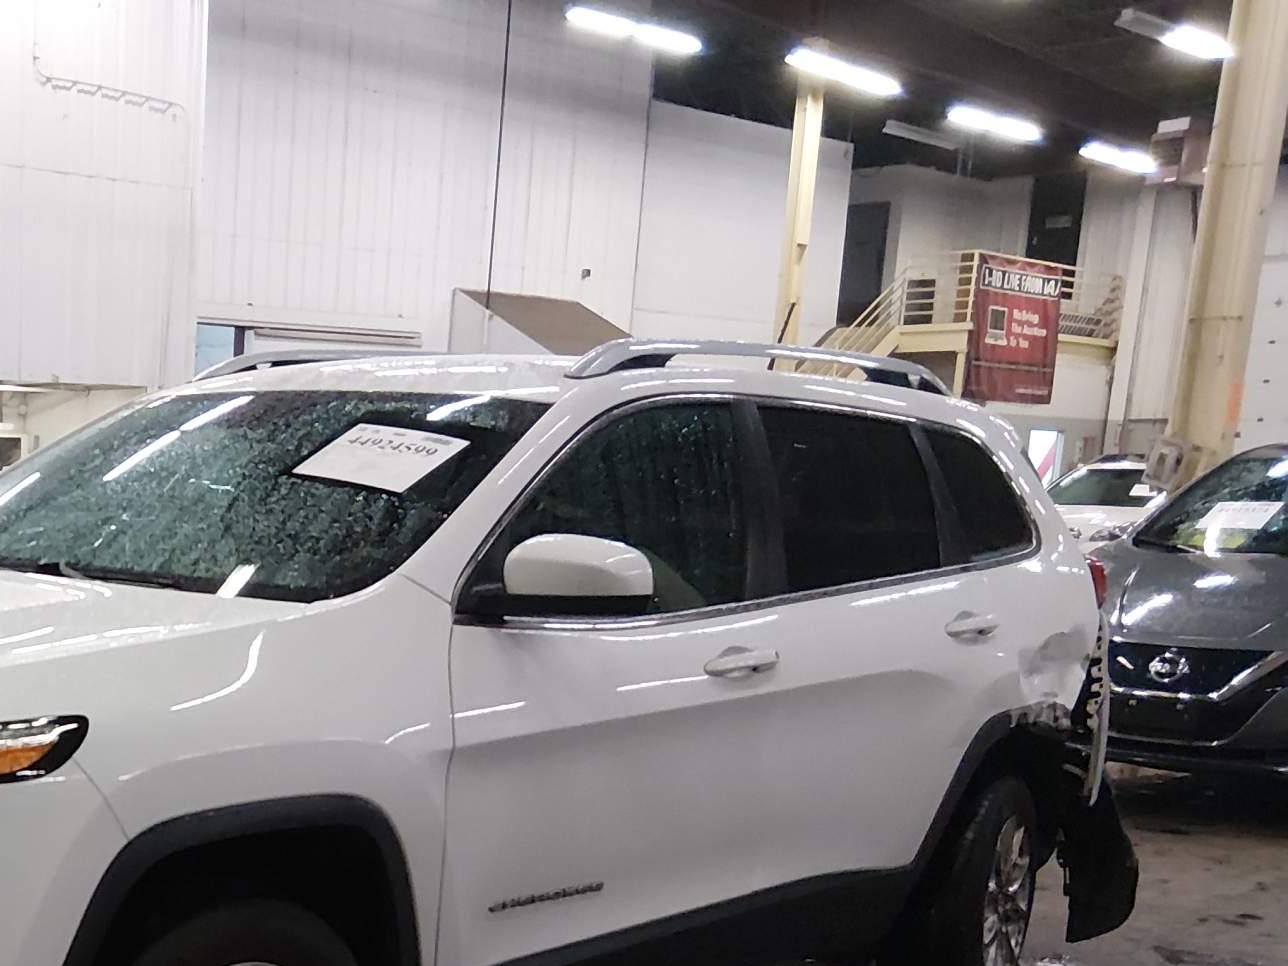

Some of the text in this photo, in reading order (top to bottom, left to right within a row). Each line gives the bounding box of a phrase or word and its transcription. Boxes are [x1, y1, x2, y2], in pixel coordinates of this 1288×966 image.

[1003, 272, 1020, 291] LIVE
[1020, 275, 1043, 294] FROM
[347, 435, 439, 457] 44924599
